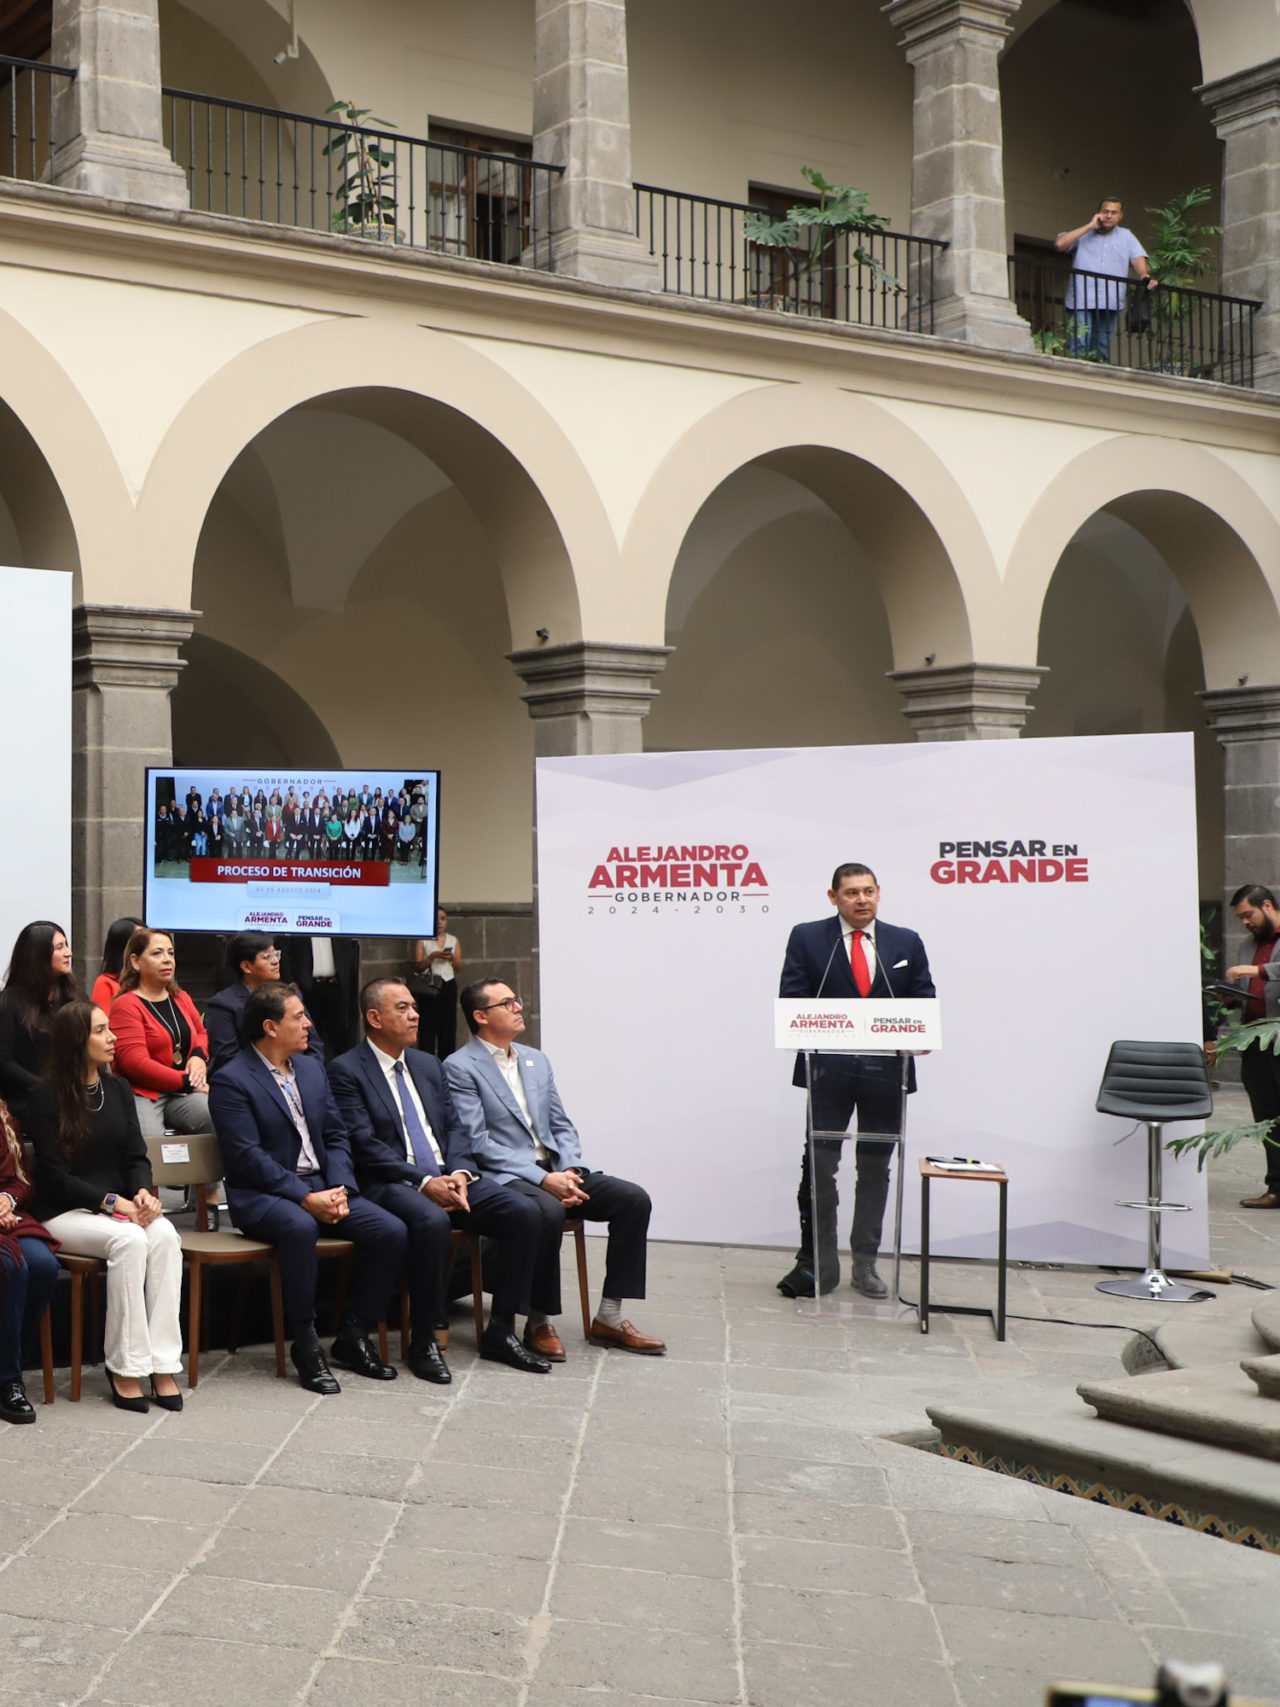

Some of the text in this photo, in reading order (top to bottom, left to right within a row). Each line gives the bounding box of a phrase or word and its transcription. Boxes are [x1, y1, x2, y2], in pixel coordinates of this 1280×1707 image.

[606, 844, 749, 863] ALEJANDRO
[939, 839, 1078, 858] PENSAR EN
[217, 865, 361, 878] PROCESO DE TRANSICIÓN
[588, 862, 769, 888] ARMENTA
[930, 858, 1089, 885] GRANDE
[615, 891, 740, 903] GOBERNADOR
[244, 916, 288, 924] ARMENTA
[790, 1019, 855, 1029] ARMENTA
[871, 1024, 926, 1033] GRANDE
